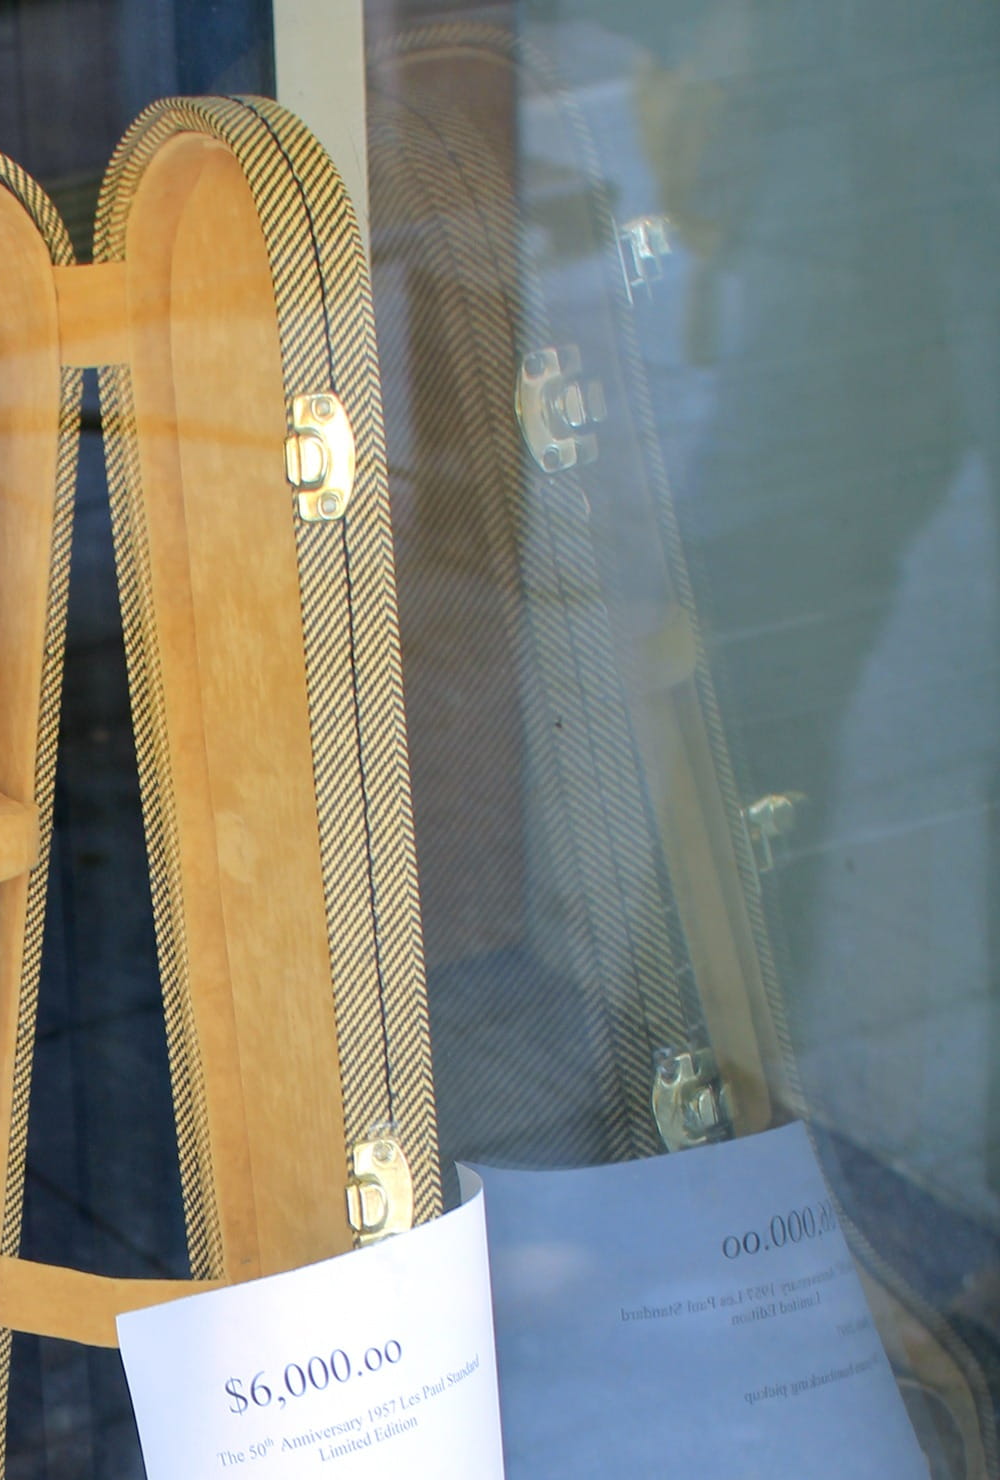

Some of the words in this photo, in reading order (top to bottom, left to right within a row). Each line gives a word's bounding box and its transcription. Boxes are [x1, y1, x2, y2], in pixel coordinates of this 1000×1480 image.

[217, 1451, 246, 1467] The
[249, 1437, 275, 1459] 50th
[280, 1416, 363, 1452] Anniversary
[368, 1400, 396, 1423] 1957
[400, 1392, 421, 1411] Les
[422, 1381, 446, 1401] Paul
[446, 1354, 481, 1388] Standard
[319, 1431, 372, 1463] Limited
[375, 1415, 419, 1443] Edition
